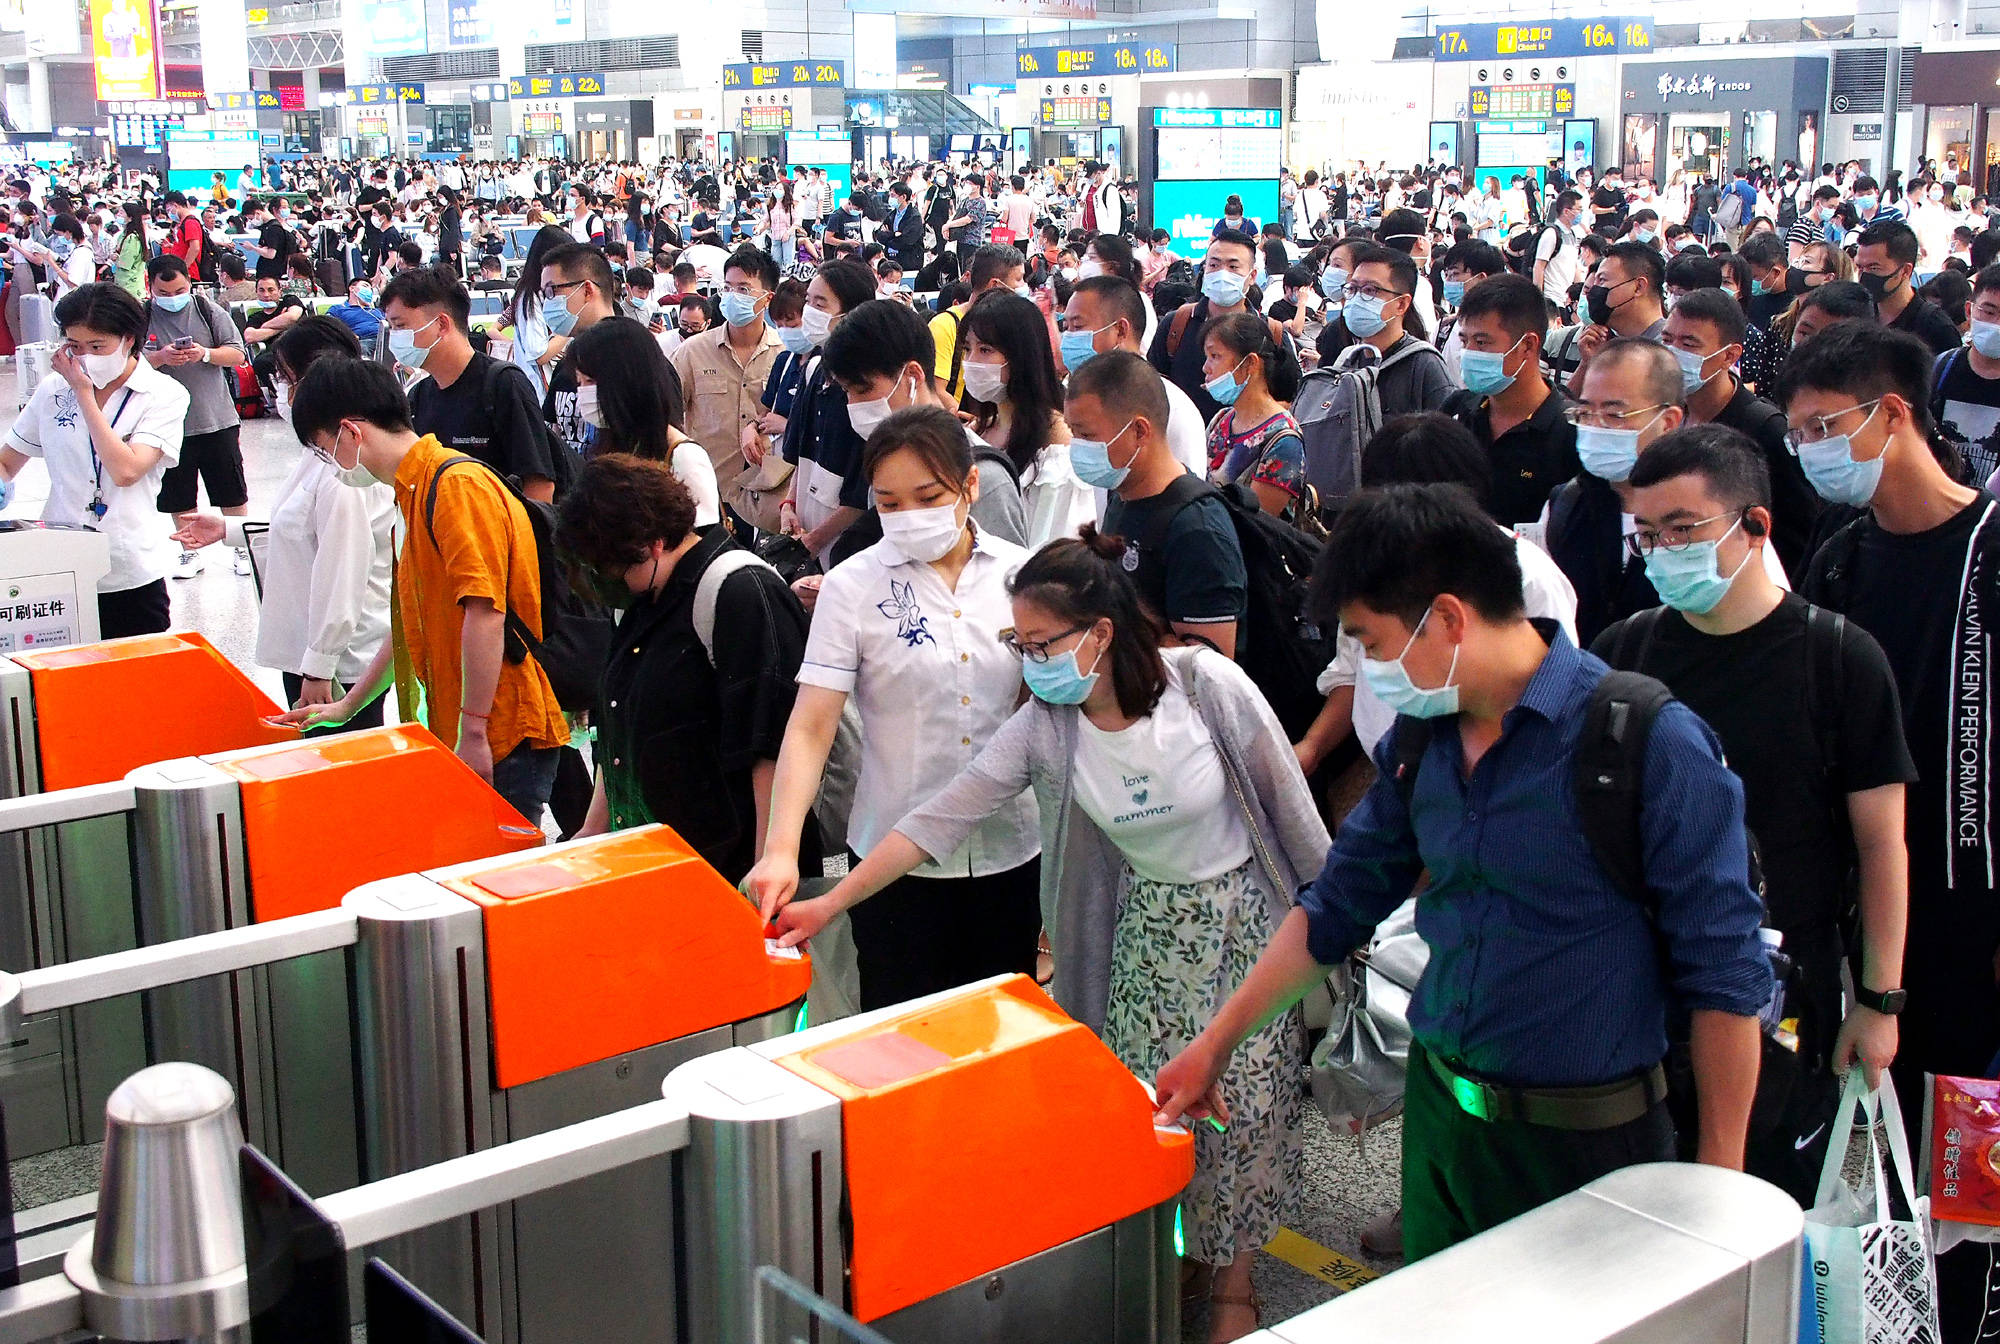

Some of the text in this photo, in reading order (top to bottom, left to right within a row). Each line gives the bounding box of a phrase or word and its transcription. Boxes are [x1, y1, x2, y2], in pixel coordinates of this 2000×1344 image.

[1438, 31, 1468, 54] 17A
[1582, 24, 1614, 47] 16A
[1624, 23, 1649, 47] 16A
[1018, 54, 1039, 72] 19A
[1114, 48, 1137, 68] 18A
[1144, 48, 1168, 67] 18A
[725, 69, 740, 85] 21A
[793, 66, 810, 82] 20A
[815, 65, 840, 82] 20A
[400, 87, 421, 100] 24A
[561, 78, 574, 93] 22A
[578, 77, 601, 93] 22A
[0, 600, 66, 622] 可刷证件
[1962, 650, 1981, 701] KLEIN
[1123, 775, 1150, 787] love
[1960, 705, 1979, 847] PERFORMANCE
[1113, 804, 1174, 823] summer
[1882, 1246, 1913, 1283] YOU ARE
